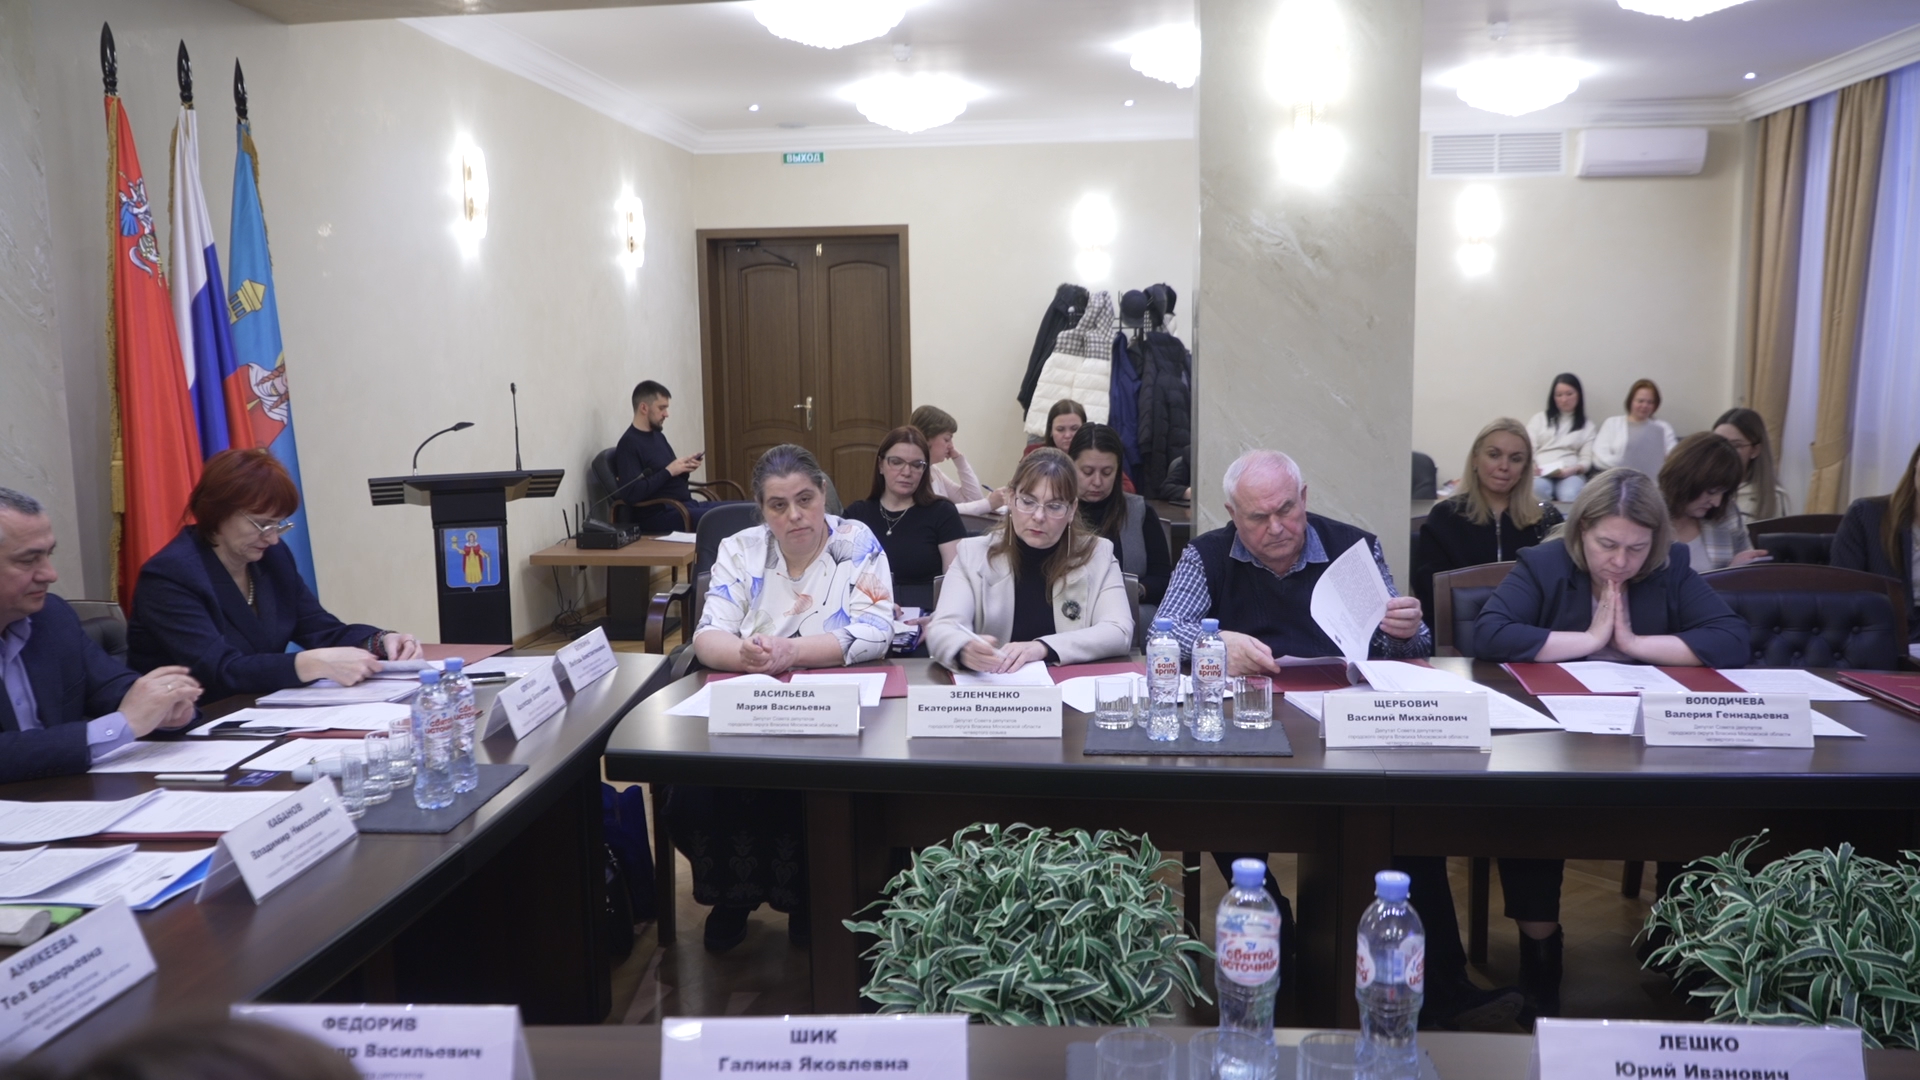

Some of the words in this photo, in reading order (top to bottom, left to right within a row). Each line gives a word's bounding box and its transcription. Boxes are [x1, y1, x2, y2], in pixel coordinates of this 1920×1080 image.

[786, 153, 820, 163] ВЫХОД
[1155, 668, 1177, 676] spring
[754, 690, 815, 698] ВАСИЛЬЕВА
[950, 691, 1020, 699] ЗЕЛЕНЧЕНКО
[736, 703, 768, 712] Мария
[771, 703, 831, 711] Васильевна
[1374, 700, 1438, 708] ЩЕРБОВИЧ
[1686, 697, 1765, 706] ВОЛОДИЧЕВА
[918, 704, 972, 713] Екатерина
[975, 704, 1052, 713] Владимировна
[1347, 713, 1396, 721] Василий
[1399, 714, 1468, 722] Михайлович
[1665, 710, 1712, 719] Валерия
[1716, 711, 1789, 720] Геннадьевна
[266, 802, 303, 829] КАБАНОВ
[250, 832, 291, 860] Владимир
[290, 806, 332, 836] Николаевич
[9, 934, 79, 980] АНИКЕЕВА
[1226, 948, 1274, 960] святой
[0, 990, 28, 1010] Теа
[28, 946, 103, 994] Валерьевна
[322, 1016, 418, 1034] ФЕДОРИВ
[790, 1028, 838, 1044] ШИК
[1659, 1034, 1740, 1053] ЛЕШКО
[364, 1044, 483, 1059] Васильевич
[718, 1057, 792, 1072] Галина
[798, 1056, 909, 1072] Яковлевна
[1614, 1060, 1676, 1080] Юрий
[1684, 1064, 1790, 1080] Иванович
